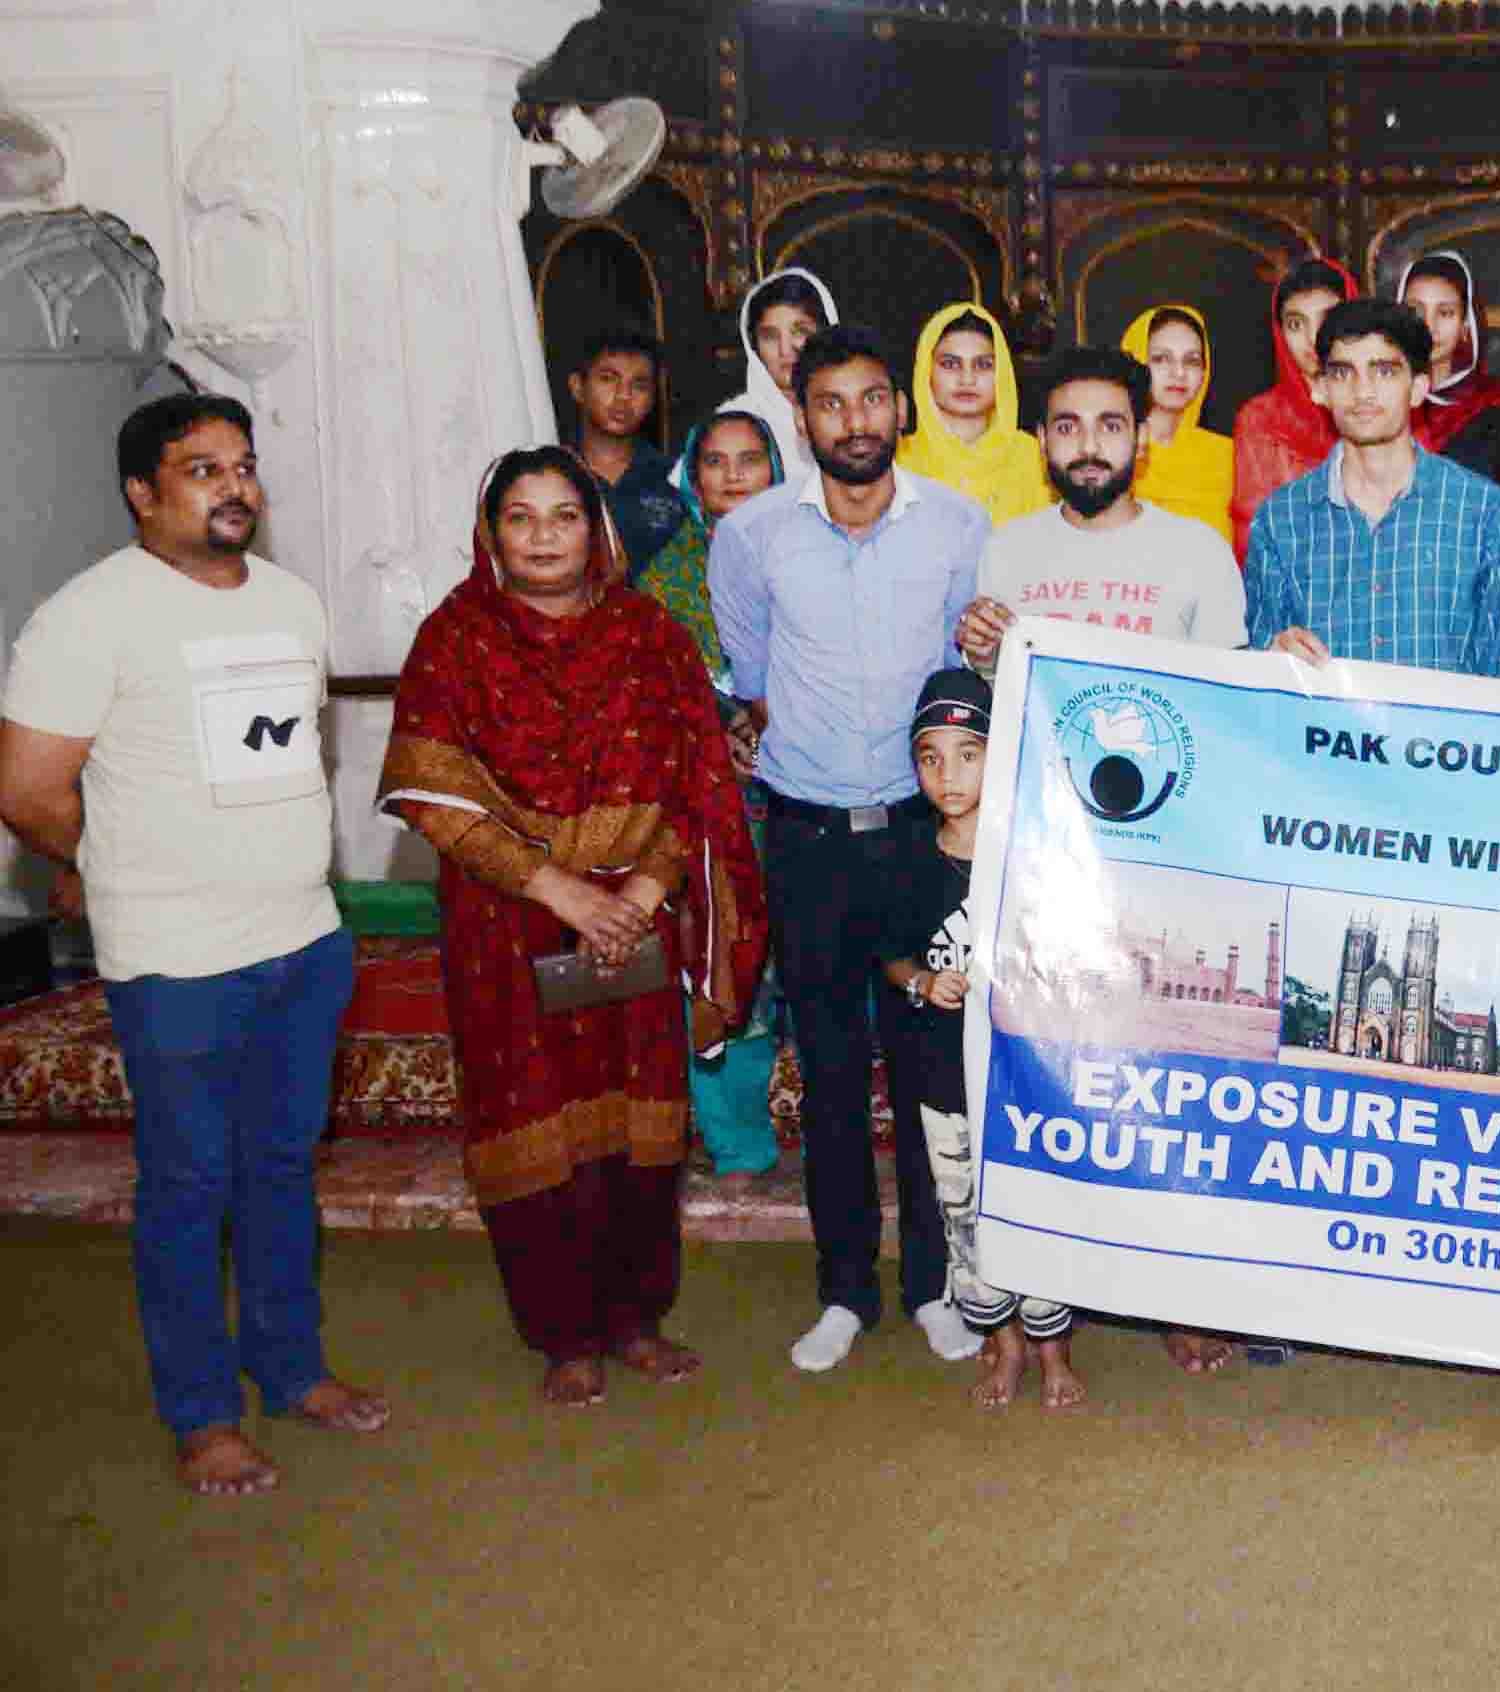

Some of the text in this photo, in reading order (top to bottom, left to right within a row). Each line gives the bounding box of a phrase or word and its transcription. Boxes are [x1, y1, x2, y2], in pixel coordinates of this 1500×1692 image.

[1018, 578, 1161, 607] SAVE THE
[1061, 681, 1197, 801] COUNCIL OF WORLD RELIGIONS
[1305, 725, 1391, 766] PAK
[1262, 814, 1432, 864] WOMEN
[1073, 1061, 1440, 1147] EXPOSURE
[1003, 1104, 1231, 1182] YOUTH
[1249, 1141, 1394, 1200] AND
[1326, 1219, 1387, 1257] On
